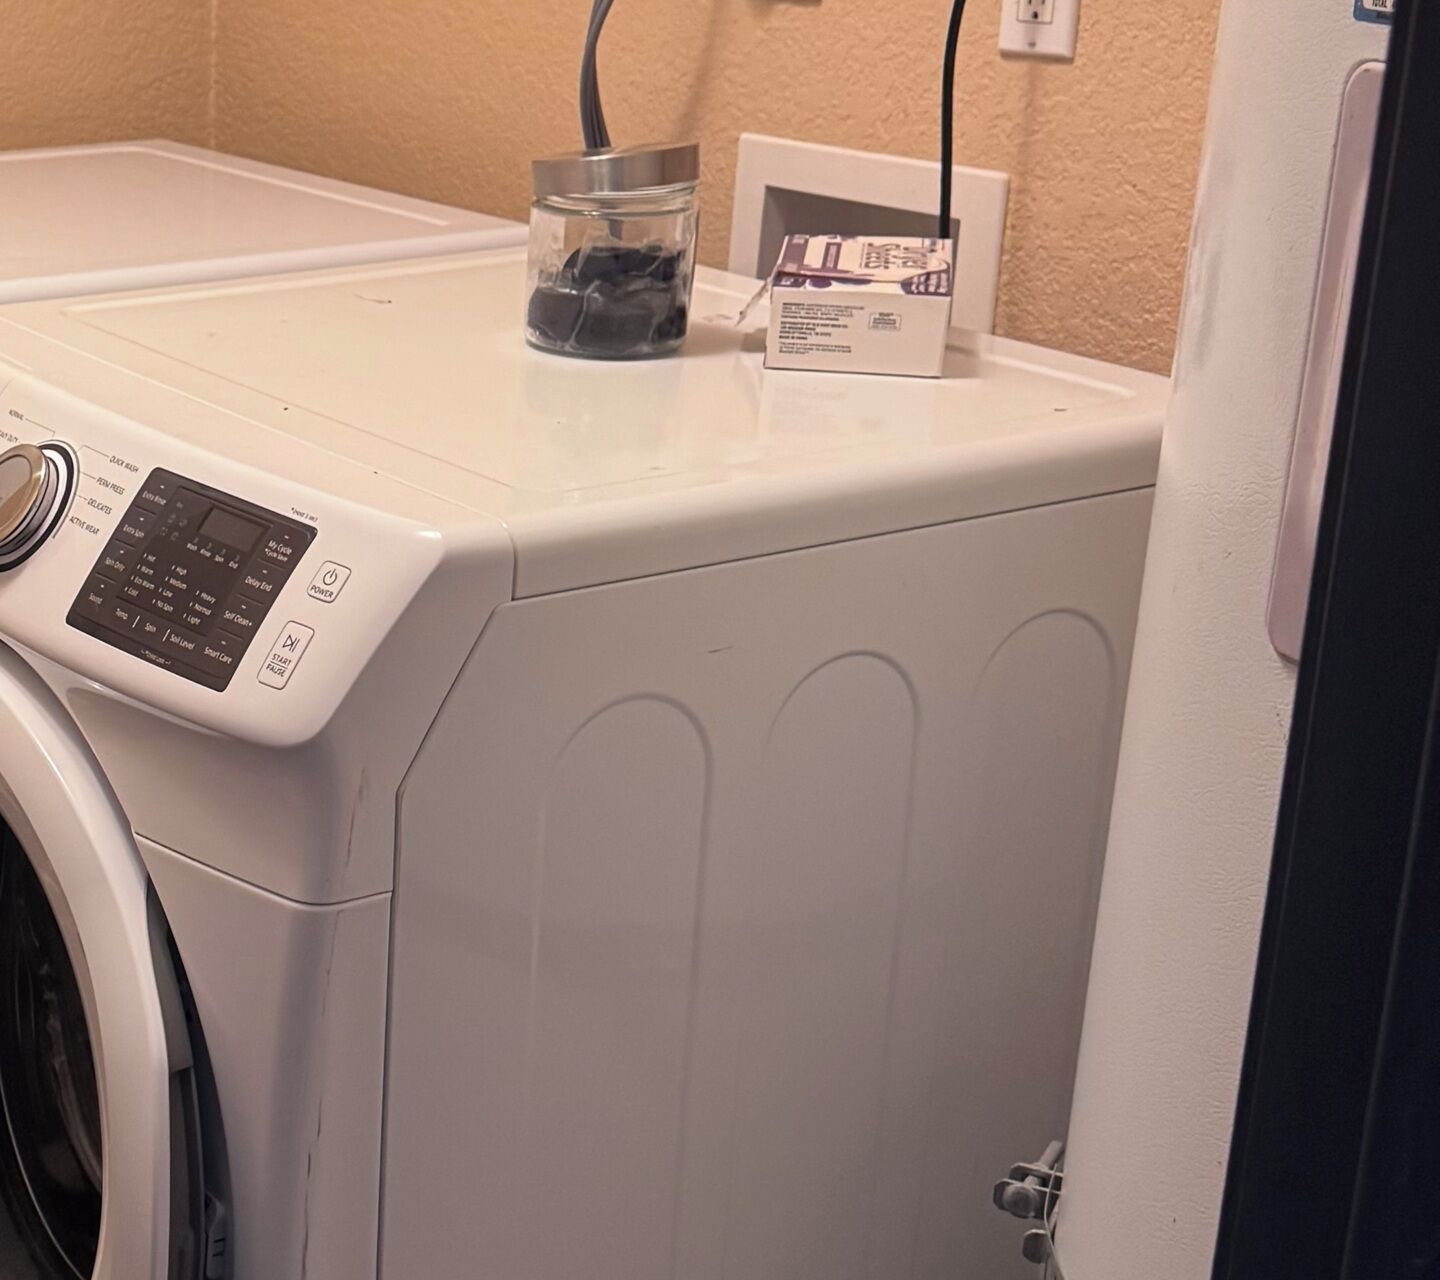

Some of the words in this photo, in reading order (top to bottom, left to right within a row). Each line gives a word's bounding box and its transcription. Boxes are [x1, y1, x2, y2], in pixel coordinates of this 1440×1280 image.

[109, 455, 125, 467] QUICK
[124, 461, 139, 474] WASH
[96, 477, 111, 490] PERM
[109, 482, 126, 496] PRESS
[87, 497, 113, 516] DELICATES
[69, 516, 86, 529] ACTIVE
[84, 521, 100, 536] WEAR
[268, 540, 278, 552] My
[277, 543, 292, 556] Cycle
[245, 575, 261, 590] Delay
[259, 580, 273, 592] End
[310, 584, 334, 599] POWER
[200, 590, 216, 604] Heavy
[194, 603, 212, 616] Normal
[223, 609, 236, 623] Self
[144, 621, 157, 634] Spin
[187, 614, 201, 626] Light
[169, 633, 181, 646] Soil
[180, 638, 195, 651] Level
[203, 646, 220, 660] Smart
[218, 651, 232, 665] Care
[271, 653, 292, 667] START
[265, 663, 286, 679] PAUSE
